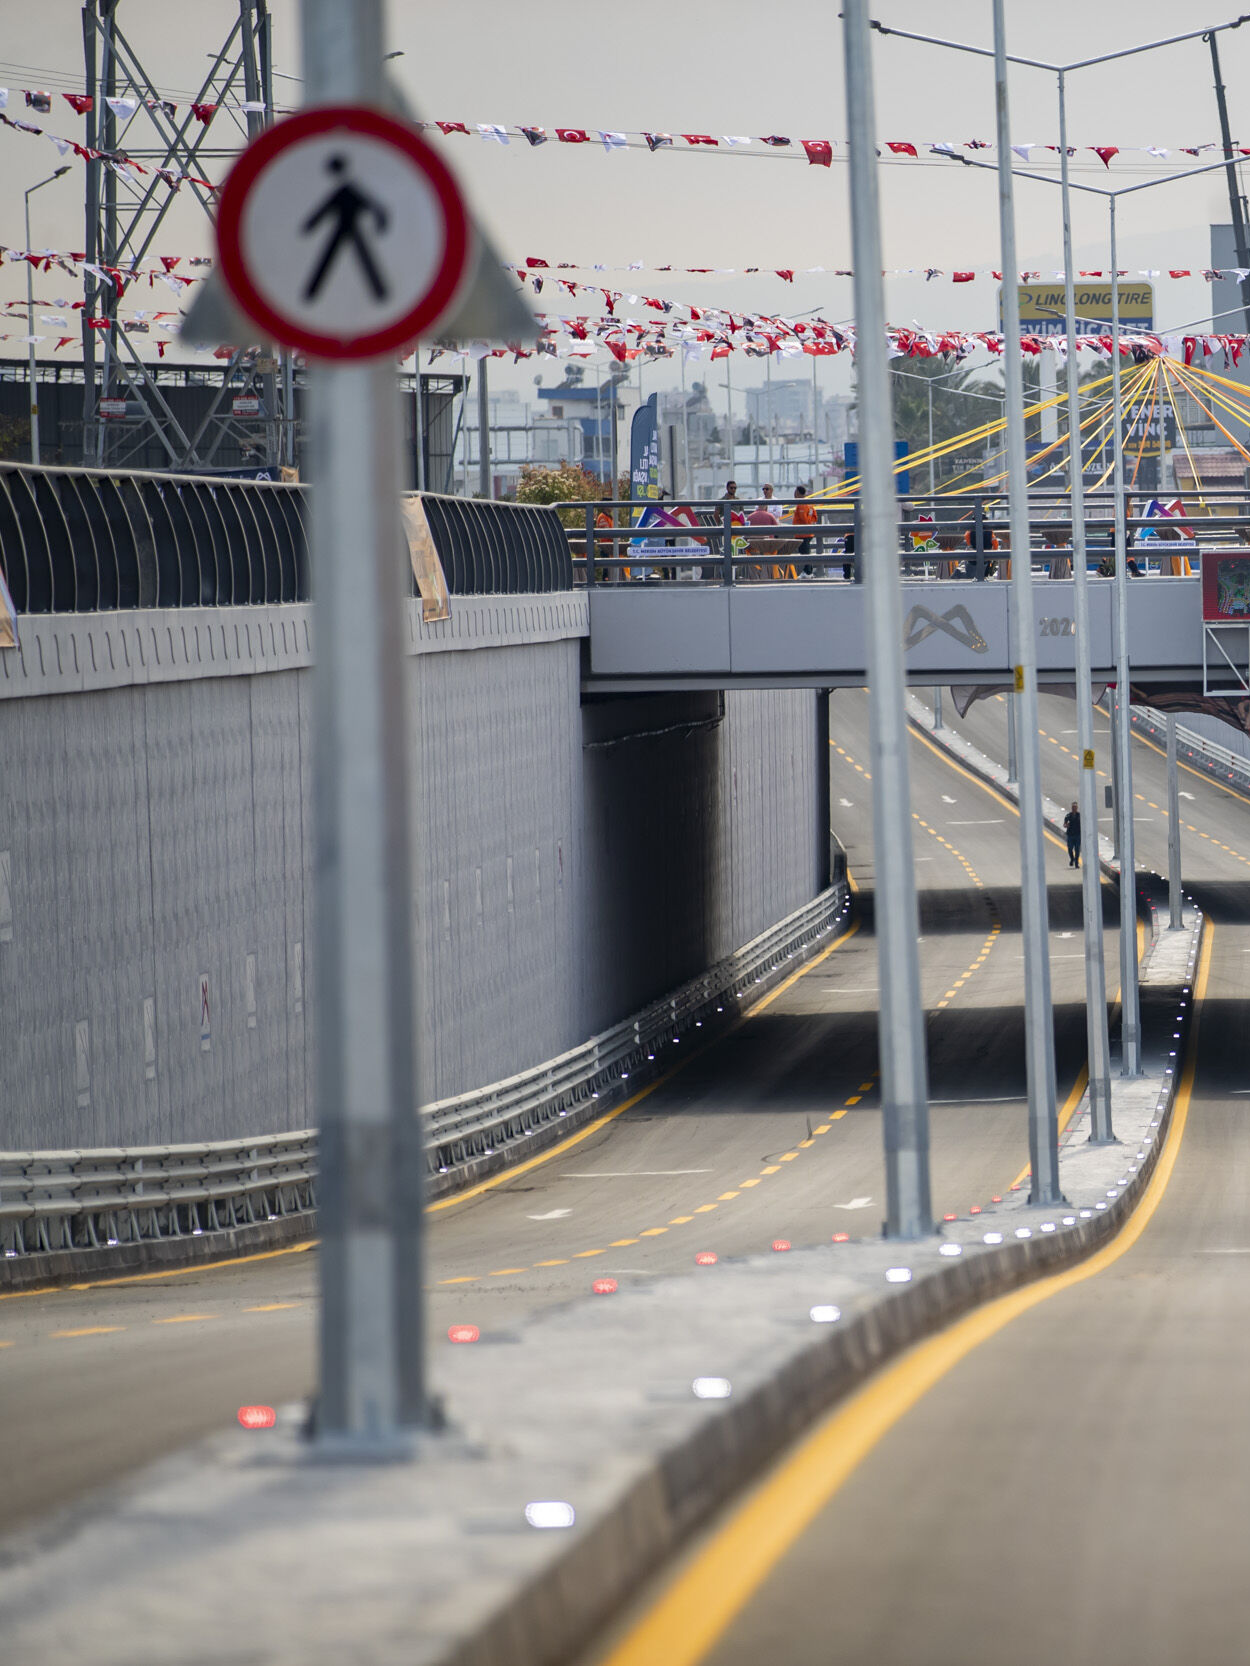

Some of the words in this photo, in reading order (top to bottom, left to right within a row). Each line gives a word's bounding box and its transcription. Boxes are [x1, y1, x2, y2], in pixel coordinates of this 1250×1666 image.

[1117, 291, 1152, 305] TIRE
[1018, 321, 1063, 336] EVİM
[1120, 405, 1174, 419] YENER
